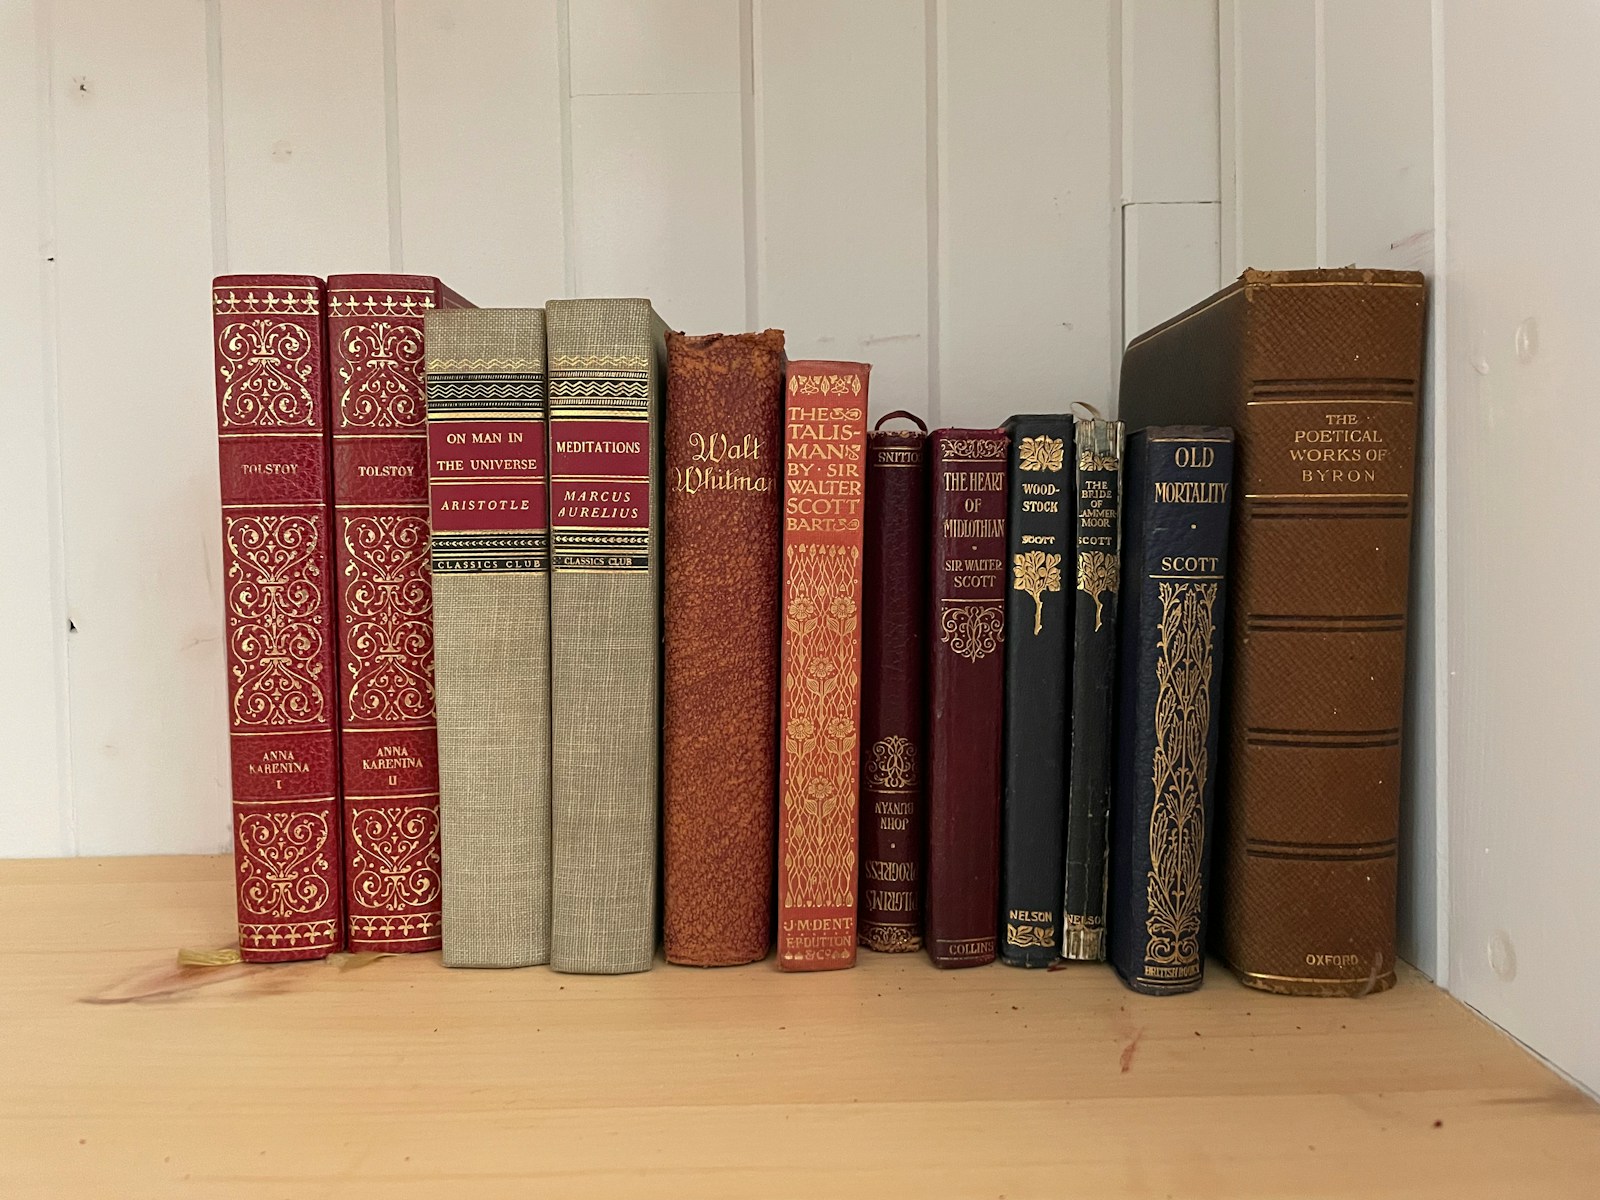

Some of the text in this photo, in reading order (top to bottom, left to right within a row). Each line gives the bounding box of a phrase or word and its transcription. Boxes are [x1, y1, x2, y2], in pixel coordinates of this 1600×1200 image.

[788, 407, 829, 421] THE
[1326, 414, 1358, 425] THE
[446, 432, 523, 444] ON MAN IN
[787, 424, 861, 441] TALIS-
[1295, 430, 1383, 443] POETICAL
[556, 441, 641, 454] MEDITATIONS
[689, 432, 765, 462] Walt
[787, 443, 846, 460] MAN
[1175, 447, 1214, 467] OLD
[1290, 449, 1388, 462] WORKS OF
[241, 464, 298, 475] TOLSTOY
[437, 459, 537, 471] THE UNIVERSE
[787, 463, 859, 477] BY SIR
[358, 466, 414, 477] TOLSTOY
[1302, 469, 1376, 482] BYRON
[787, 479, 862, 496] WALTER
[944, 472, 1005, 491] THE HEART
[1085, 481, 1108, 490] THE
[1022, 484, 1060, 496] WOOD-
[1081, 490, 1113, 499] BRIDE
[1155, 482, 1229, 503] MORTALITY
[564, 491, 631, 502] MARCUS
[441, 500, 530, 511] ARISTOTLE
[787, 498, 860, 515] SCOTT
[965, 498, 982, 513] OF
[1022, 501, 1058, 512] STOCK
[1090, 500, 1103, 508] OF
[558, 507, 639, 519] AURELIUS
[787, 518, 834, 531] BART
[943, 519, 1005, 538] MIDLOTHIAN
[1081, 518, 1111, 527] MOOR
[1021, 535, 1055, 544] SCOTT
[1078, 536, 1112, 545] SCOTT
[437, 559, 541, 569] CLASSICS CLUB
[564, 557, 632, 566] CLASSICS CLUB
[945, 560, 1003, 571] SIR WALTER
[1161, 557, 1218, 571] SCOTT
[953, 576, 997, 588] SCOTT
[262, 750, 294, 761] ANNA
[377, 746, 408, 757] ANNA
[249, 762, 310, 774] KARENINA
[362, 757, 424, 769] KARENINA
[874, 802, 914, 815] BUNYAN
[880, 817, 909, 830] JOHN
[1009, 910, 1053, 922] NELSON
[1067, 914, 1103, 925] NELSO
[949, 941, 994, 956] COLLINS
[1306, 953, 1359, 966] OXFORD
